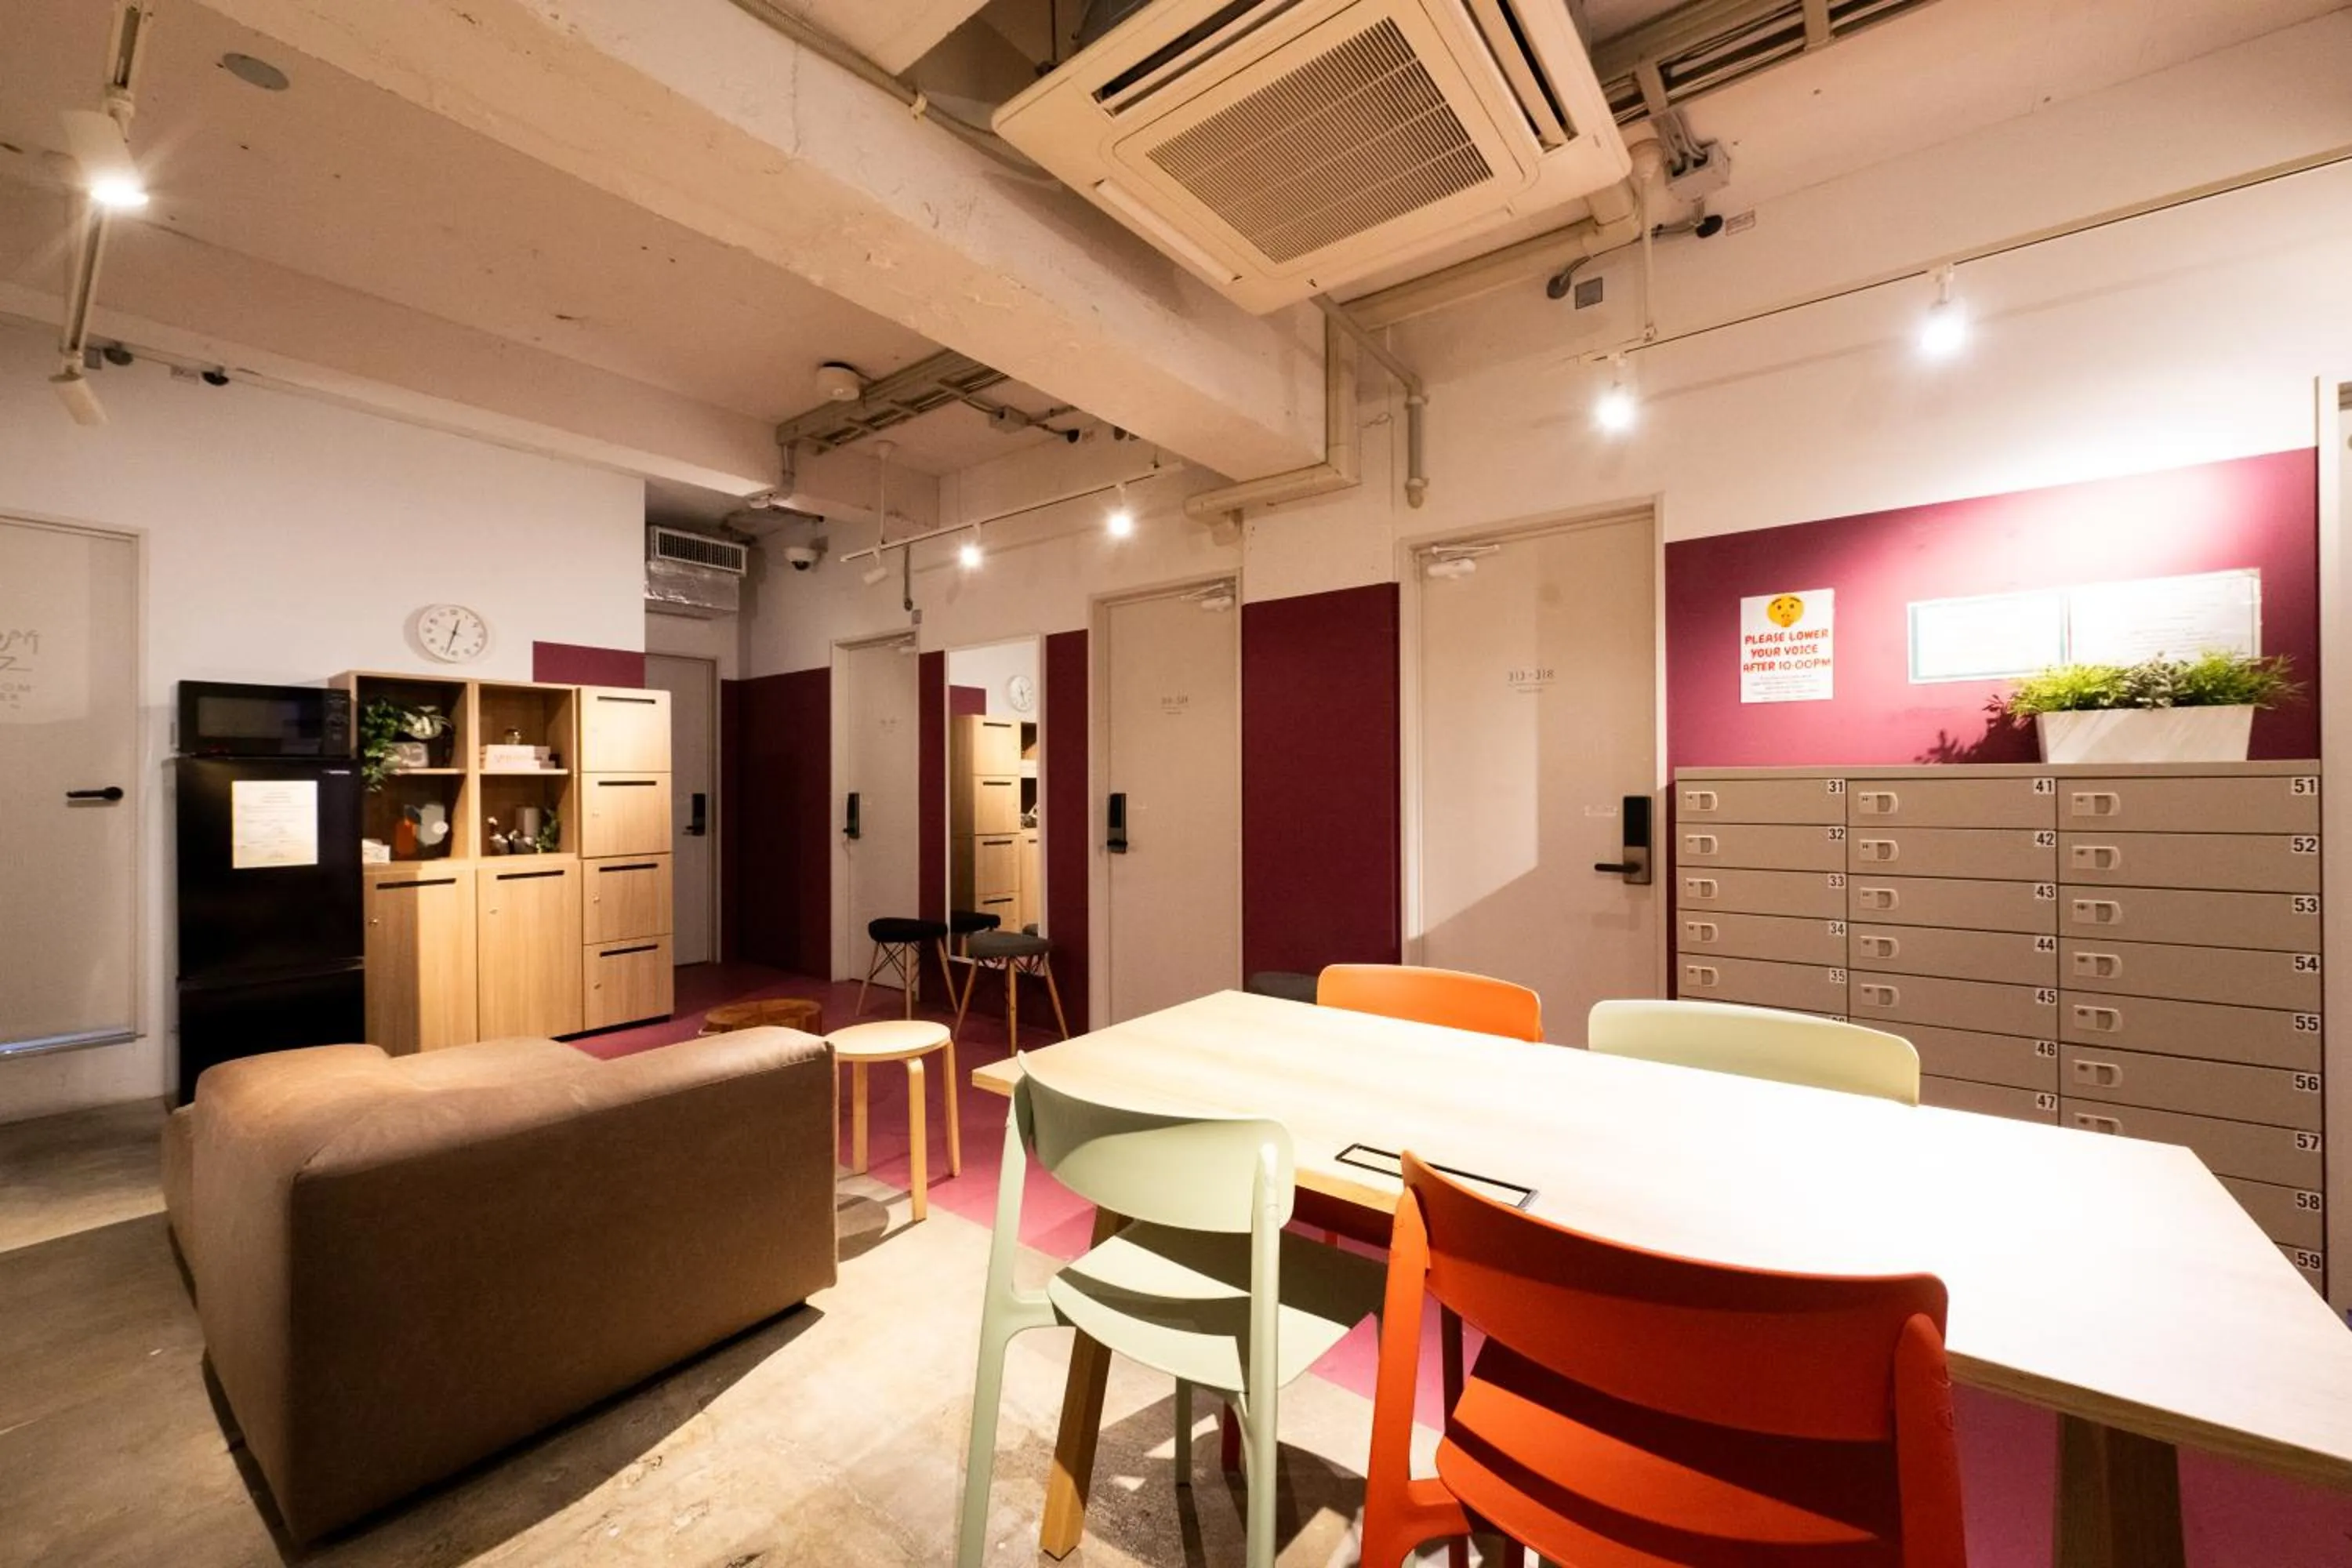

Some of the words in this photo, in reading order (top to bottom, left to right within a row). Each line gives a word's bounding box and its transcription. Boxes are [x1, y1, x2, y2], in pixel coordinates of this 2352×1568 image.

[1744, 632, 1785, 644] PLEASE
[1789, 629, 1829, 641] LOWER
[1751, 647, 1781, 659] YOUR
[1784, 644, 1819, 655] VOICE
[1743, 661, 1776, 673] AFTER
[1829, 780, 1843, 793] 31
[2036, 780, 2052, 792] 41
[2295, 779, 2314, 793] 51
[1829, 828, 1844, 840] 32
[2037, 833, 2054, 845] 42
[2293, 838, 2316, 852] 52
[1831, 875, 1844, 887] 33
[2037, 886, 2054, 898] 43
[2295, 898, 2317, 913] 53
[1831, 922, 1844, 935] 34
[2038, 938, 2054, 950] 44
[2295, 956, 2318, 971] 54
[1831, 970, 1845, 982] 35
[2038, 990, 2055, 1004] 45
[2295, 1016, 2318, 1031] 55
[2038, 1043, 2055, 1056] 46
[2295, 1075, 2318, 1091] 56
[2038, 1095, 2055, 1109] 47
[2296, 1134, 2318, 1150] 57
[2296, 1193, 2319, 1210] 58
[2297, 1253, 2320, 1269] 59
